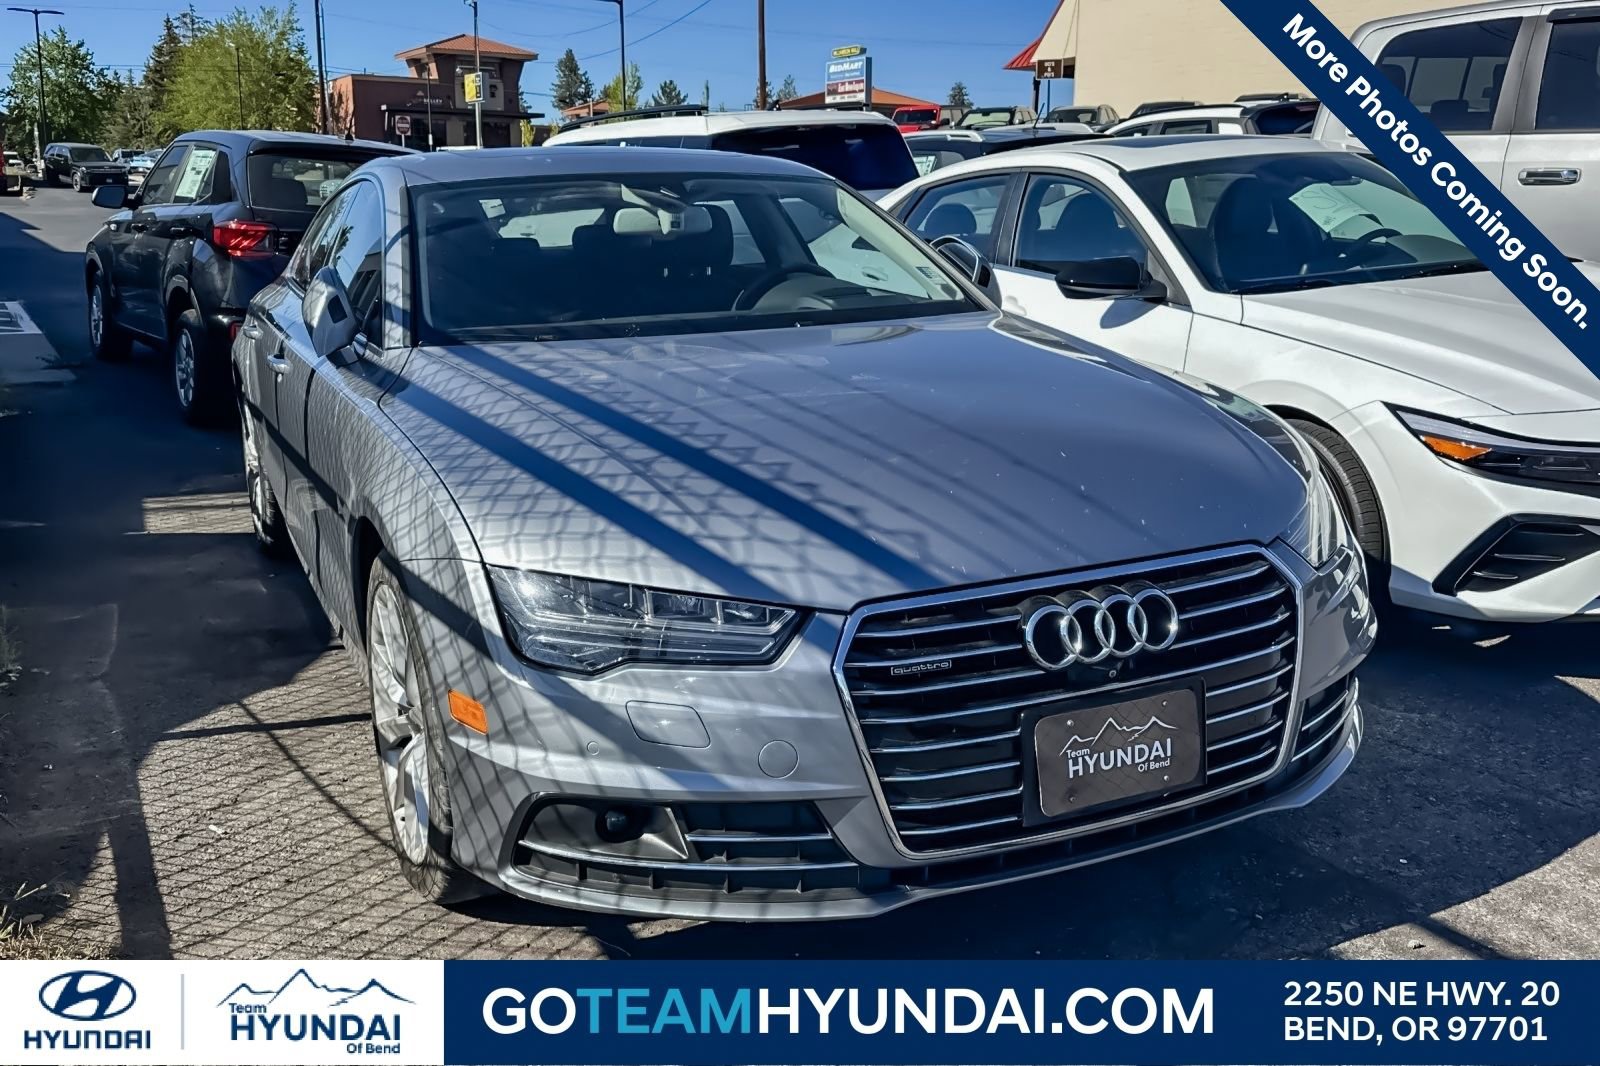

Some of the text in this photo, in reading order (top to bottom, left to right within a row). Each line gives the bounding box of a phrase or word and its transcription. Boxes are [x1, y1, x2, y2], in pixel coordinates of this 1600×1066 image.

[893, 661, 949, 675] quattro
[1066, 748, 1090, 759] Team
[1068, 738, 1172, 779] HYUNDAI
[1138, 758, 1171, 772] Of Bend
